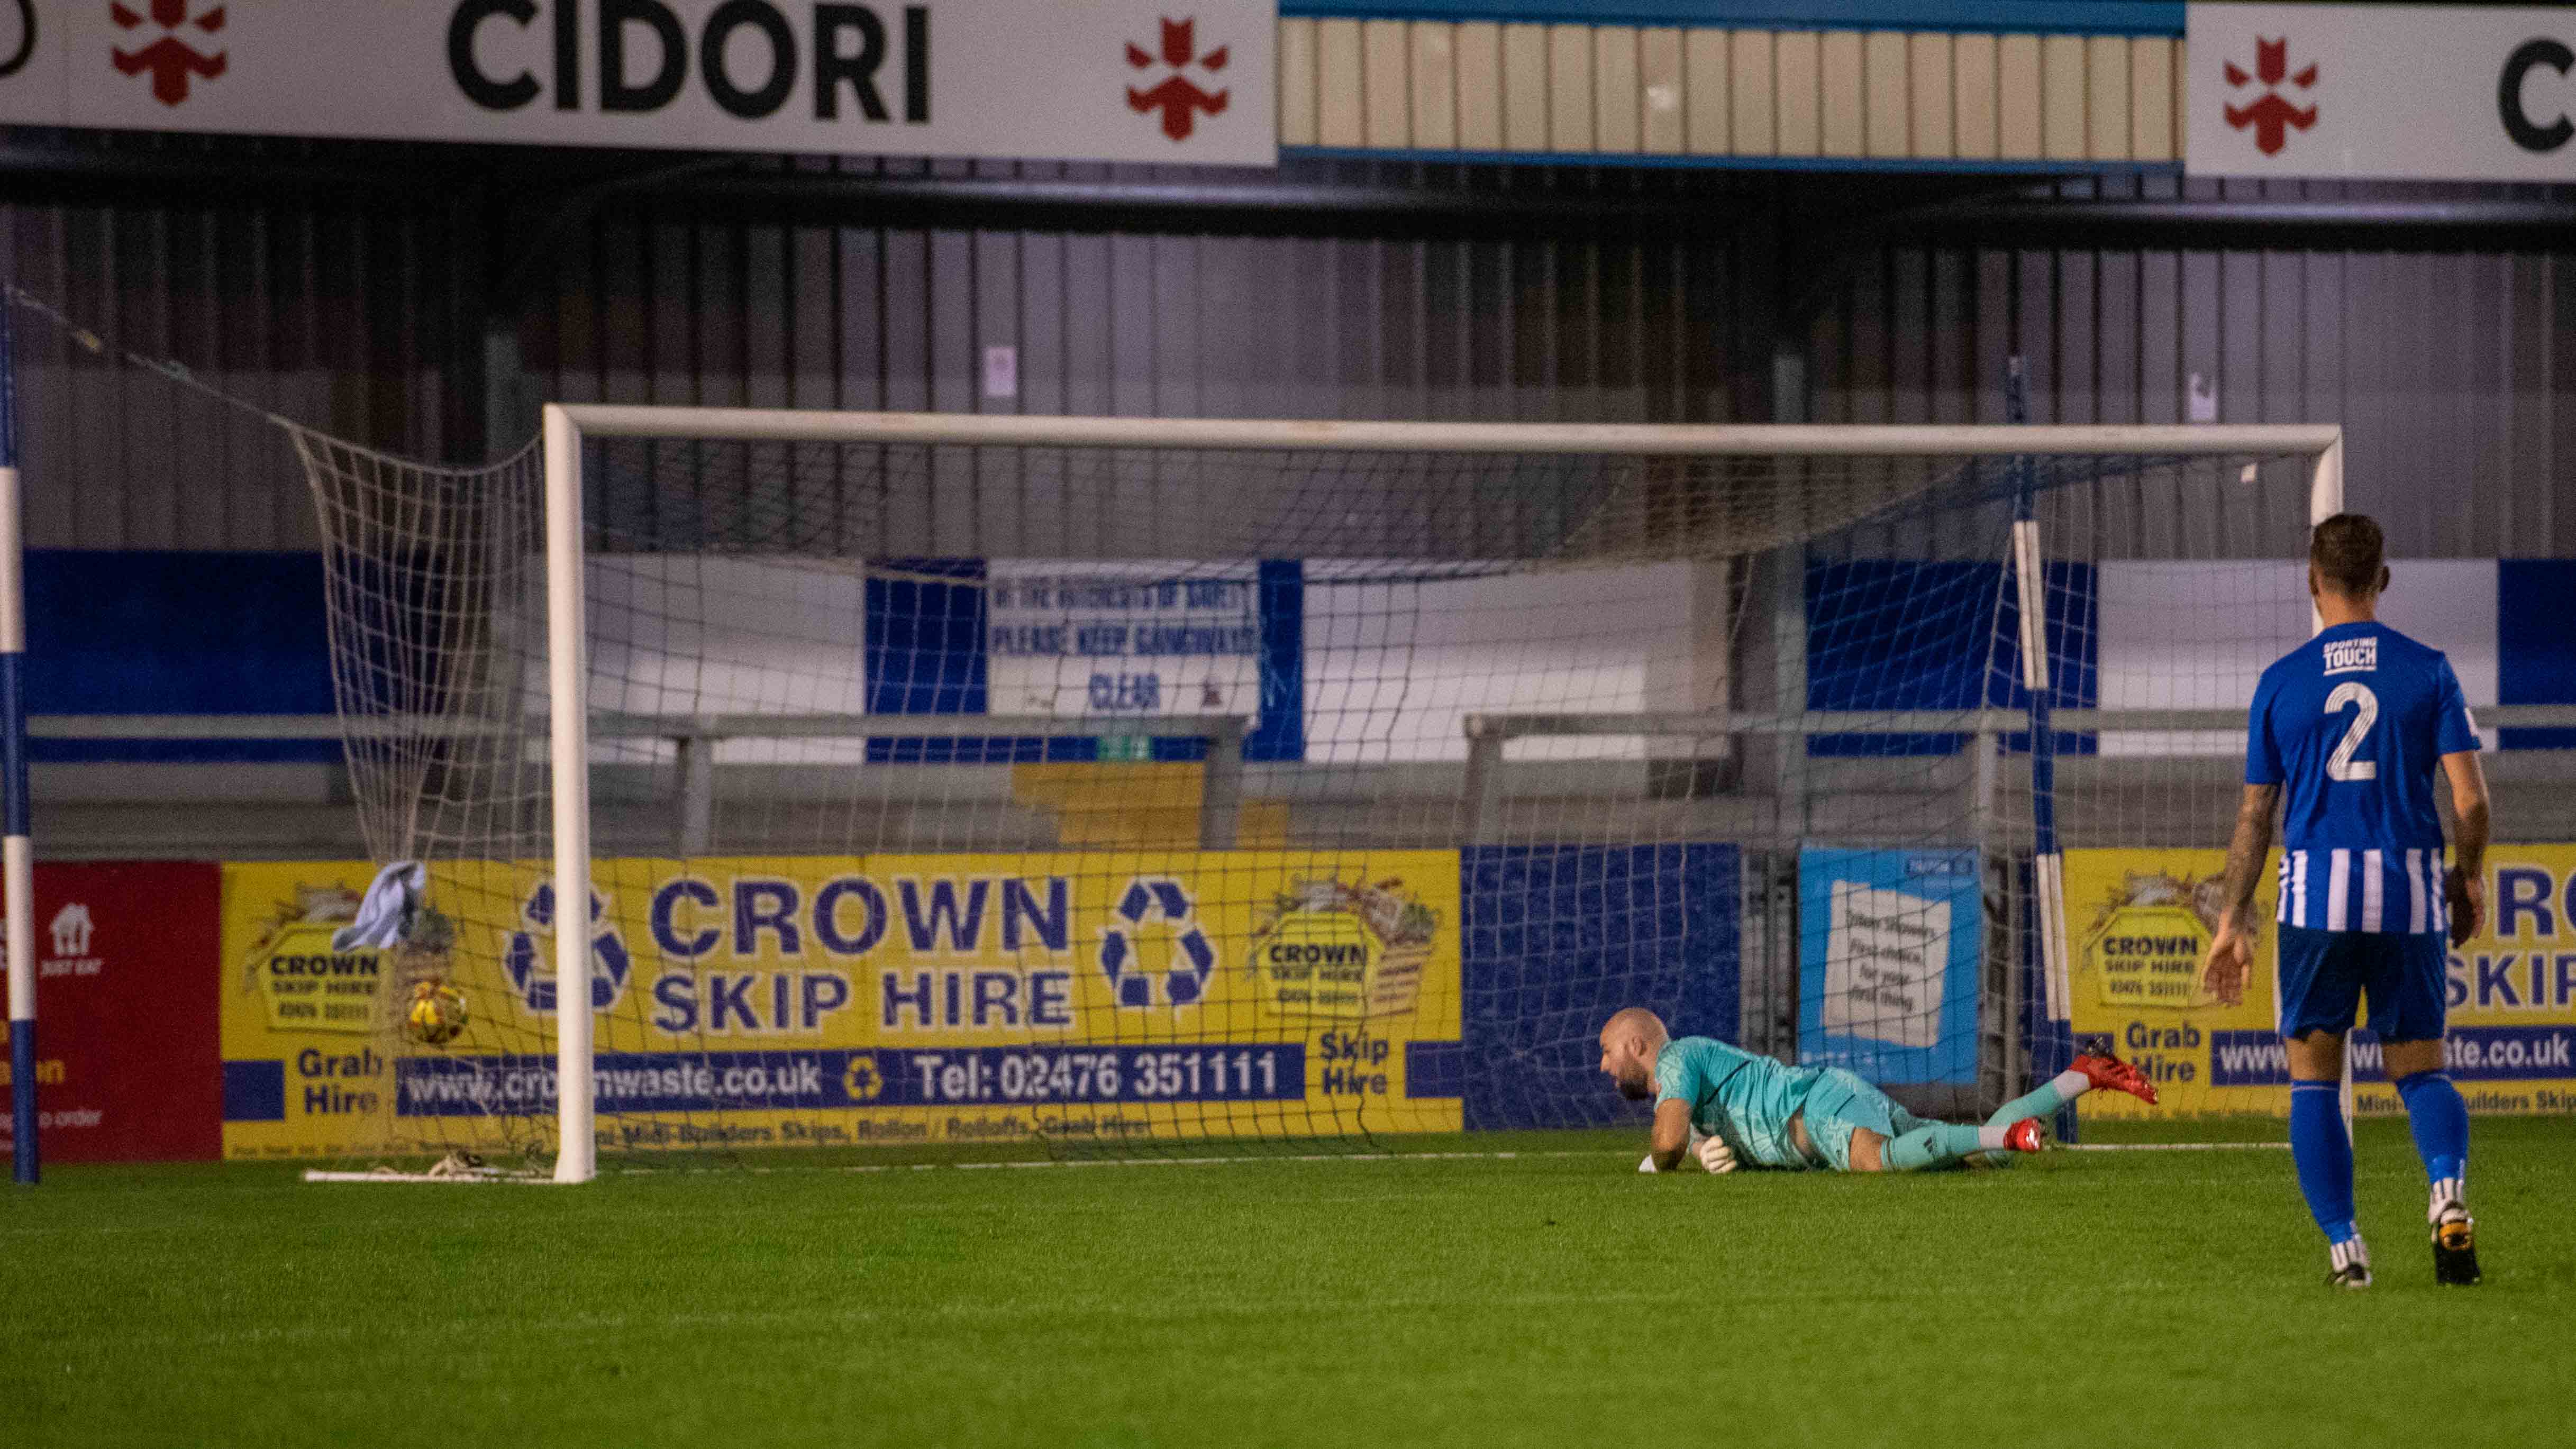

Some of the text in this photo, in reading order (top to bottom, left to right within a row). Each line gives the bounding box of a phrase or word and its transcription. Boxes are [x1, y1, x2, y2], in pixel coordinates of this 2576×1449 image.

[447, 0, 930, 123] CIDORI
[1078, 626, 1127, 654] KEEP
[2324, 636, 2378, 653] SPORTING
[2323, 650, 2377, 669] TOUCH
[1089, 675, 1160, 709] CLEAR
[2324, 681, 2378, 781] 2
[651, 878, 1069, 956] CROWN
[1270, 944, 1367, 964] CROWN
[2103, 937, 2198, 955] CROWN
[271, 955, 379, 975] CROWN
[2105, 960, 2194, 973] SKIP HIRE
[654, 972, 1071, 1033] SKIP HIRE
[1321, 1033, 1388, 1065] Skip
[2127, 1021, 2201, 1050] Grab
[298, 1049, 383, 1078] Grab
[406, 1051, 1277, 1102] www.cronwaste.co.uk Tel: 02476 351111
[2132, 1055, 2196, 1082] Hire
[1323, 1068, 1387, 1095] Hire
[304, 1085, 379, 1115] Hire
